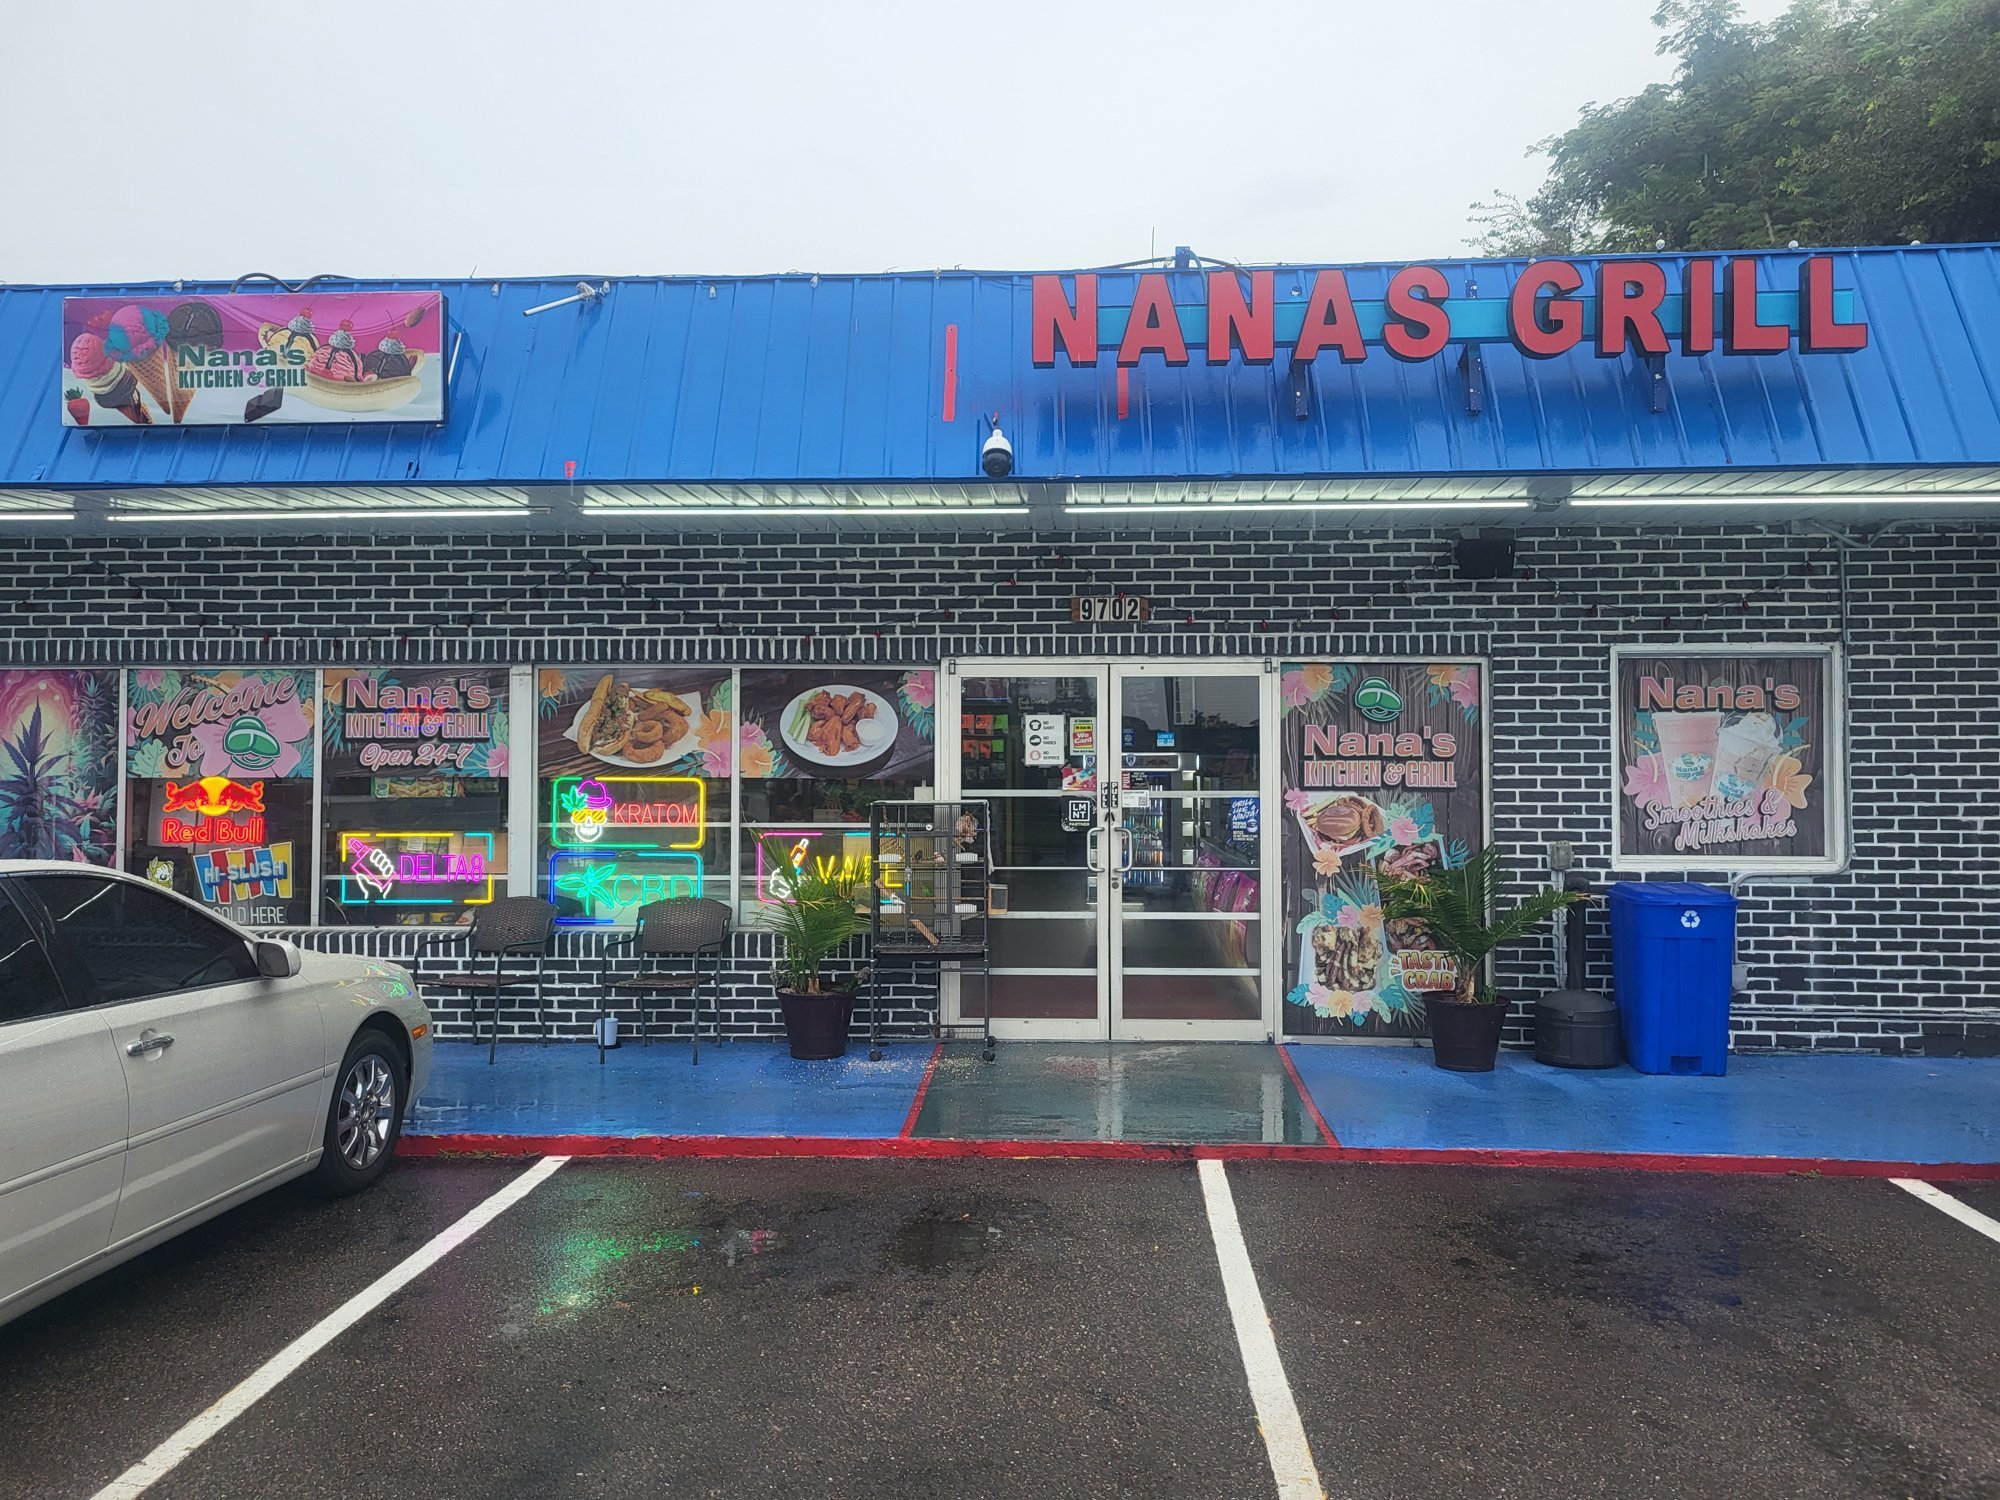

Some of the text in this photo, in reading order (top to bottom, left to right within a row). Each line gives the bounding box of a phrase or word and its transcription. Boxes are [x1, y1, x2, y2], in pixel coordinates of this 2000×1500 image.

[1032, 257, 1868, 367] NANAS GRILL
[178, 344, 307, 367] Nana's
[178, 369, 308, 388] KITCHEN & GRILL
[1081, 598, 1139, 620] 9702
[135, 675, 297, 739] Welcome
[345, 678, 491, 709] Nana's
[1639, 677, 1801, 710] Nana's
[345, 712, 490, 739] KITCHEN & GRILL
[168, 732, 205, 768] To
[1304, 724, 1457, 758] Nana's
[360, 743, 475, 771] Open 24-7
[1304, 761, 1457, 788] KITCHEN & GRILL
[614, 803, 699, 826] KRATOM
[1645, 789, 1778, 829] Smoothies &
[162, 816, 265, 844] Red Bull
[1675, 815, 1797, 851] Milkshakes
[204, 860, 286, 885] HI-SLUSH
[613, 873, 695, 907] CBD
[251, 906, 285, 924] HERE
[1402, 970, 1454, 990] CRAB
